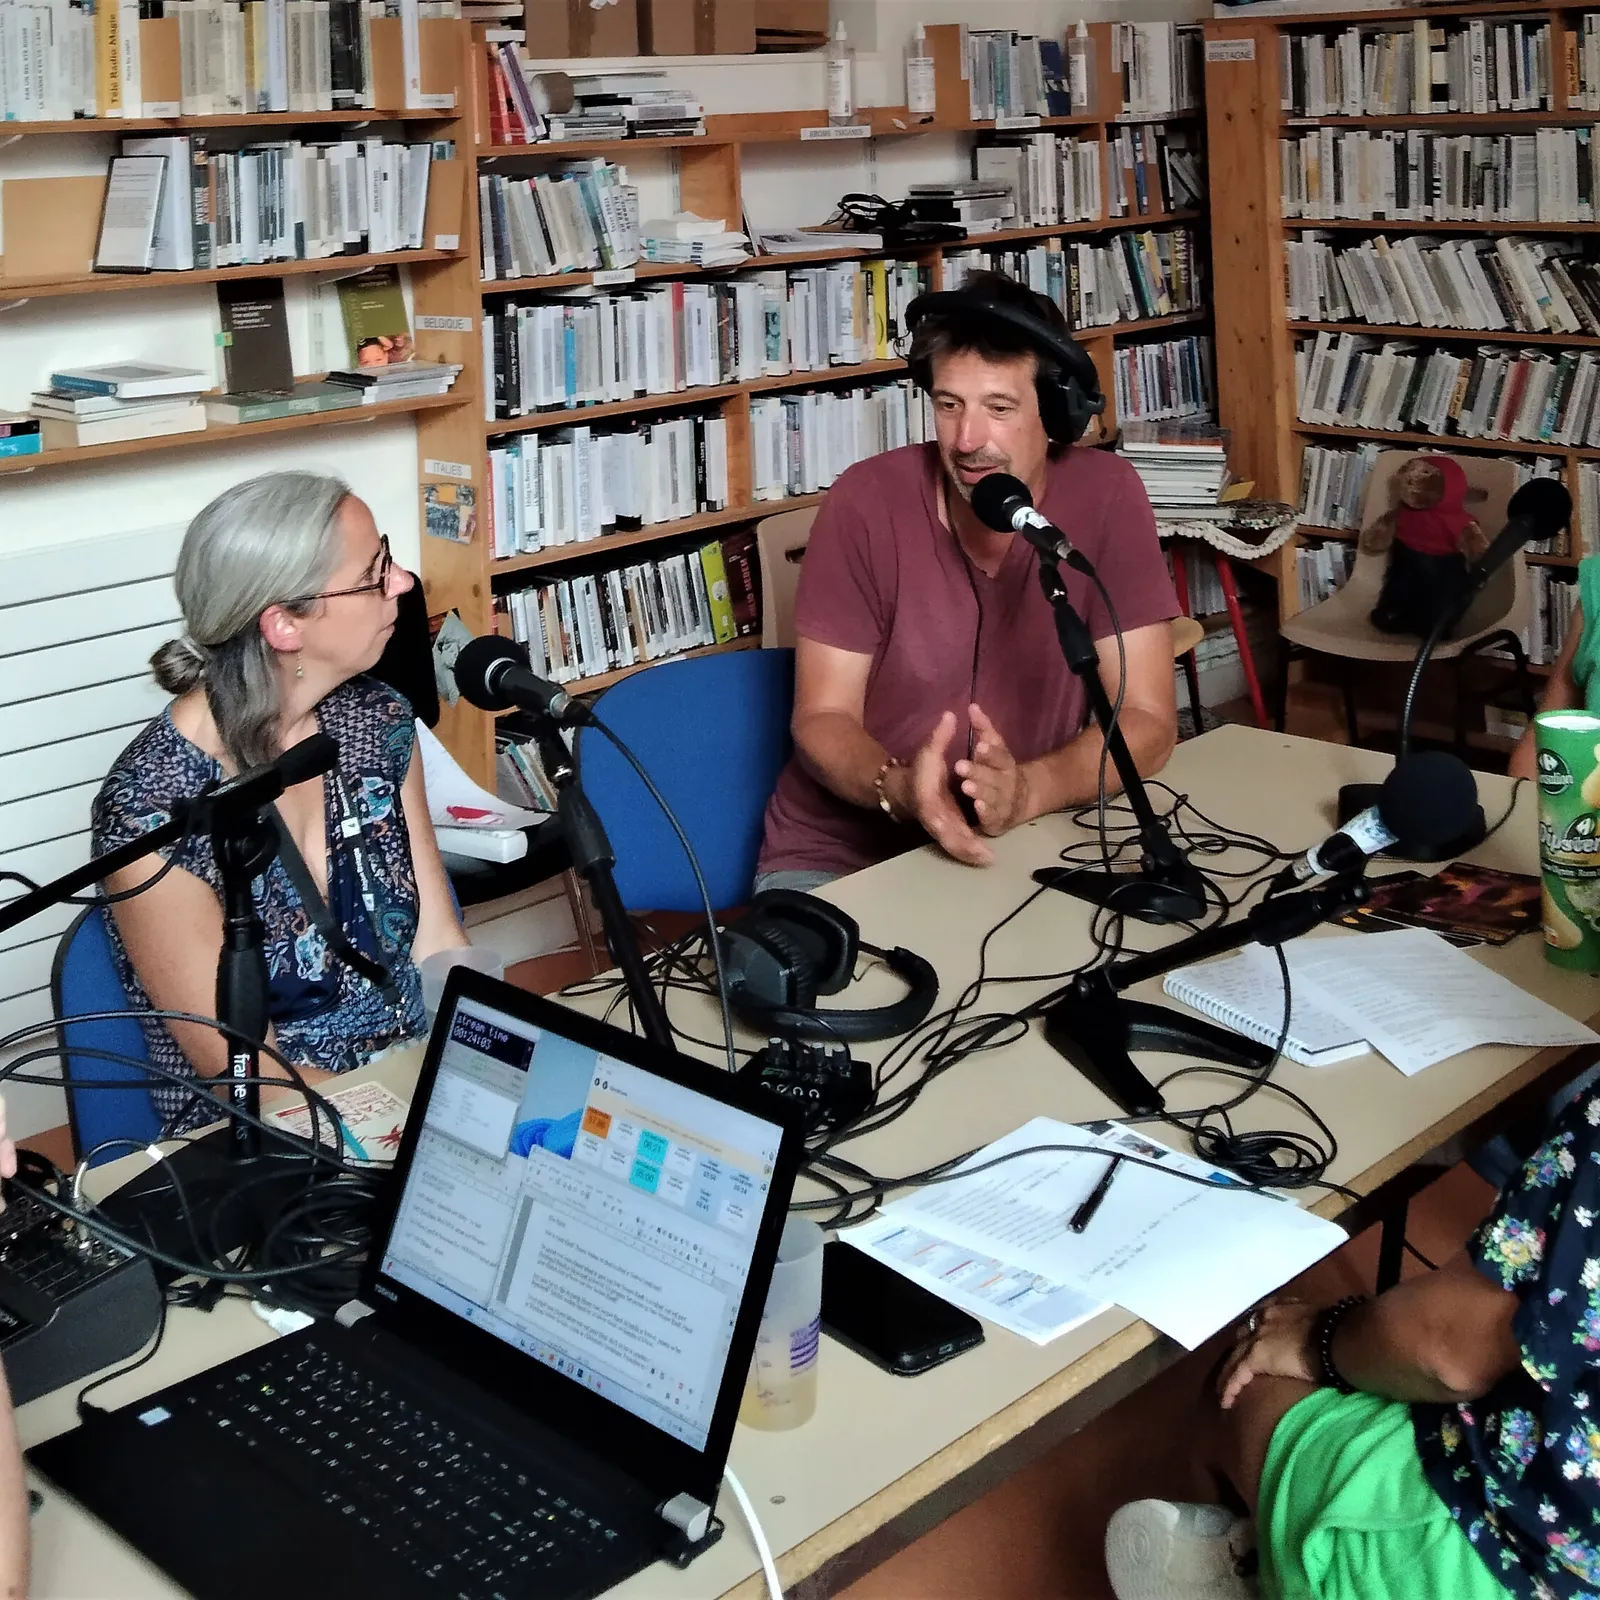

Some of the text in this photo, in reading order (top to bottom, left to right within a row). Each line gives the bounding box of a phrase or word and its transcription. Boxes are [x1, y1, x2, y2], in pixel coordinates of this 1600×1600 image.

[108, 14, 119, 104] Télé Radio Magie
[1209, 50, 1252, 60] BRETAGNE
[423, 317, 464, 330] BELGIQUE
[740, 557, 752, 591] MEDEM
[453, 1026, 492, 1050] 00:24:03
[456, 1014, 509, 1042] stream time
[234, 1053, 250, 1140] fraewks
